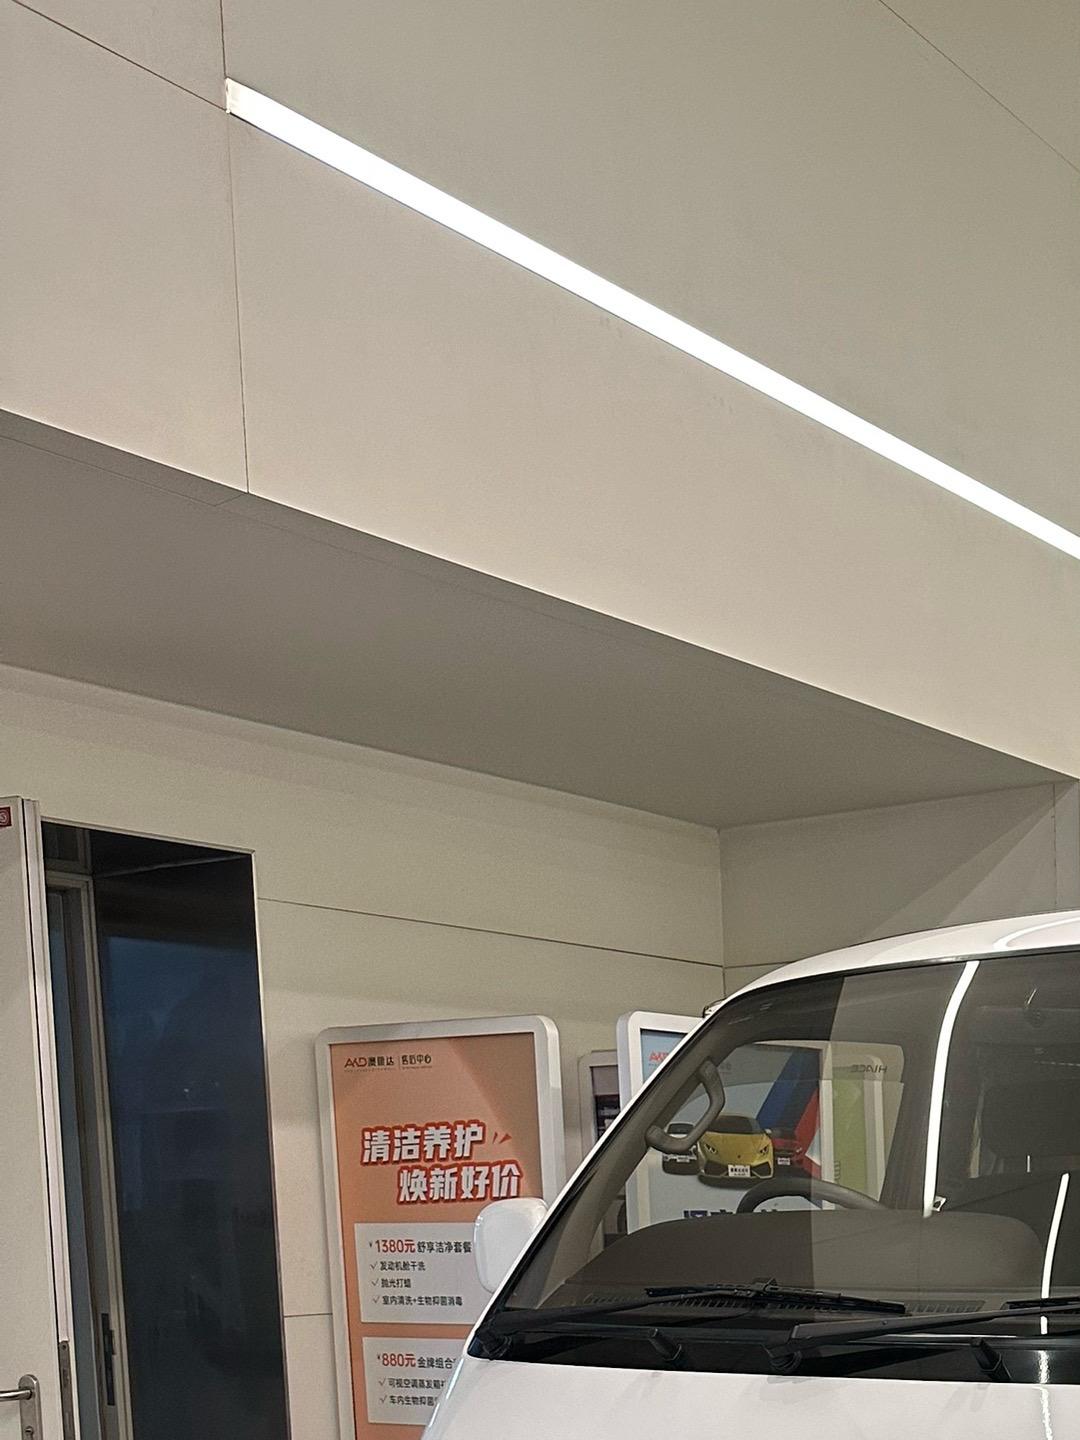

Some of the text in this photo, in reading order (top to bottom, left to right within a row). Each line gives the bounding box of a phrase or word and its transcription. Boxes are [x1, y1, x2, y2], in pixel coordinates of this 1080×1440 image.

[361, 1121, 485, 1164] 清洁养护
[398, 1162, 522, 1203] 焕新好价
[417, 1356, 456, 1369] 金牌组合
[389, 1395, 438, 1406] 车内生物抑菌
